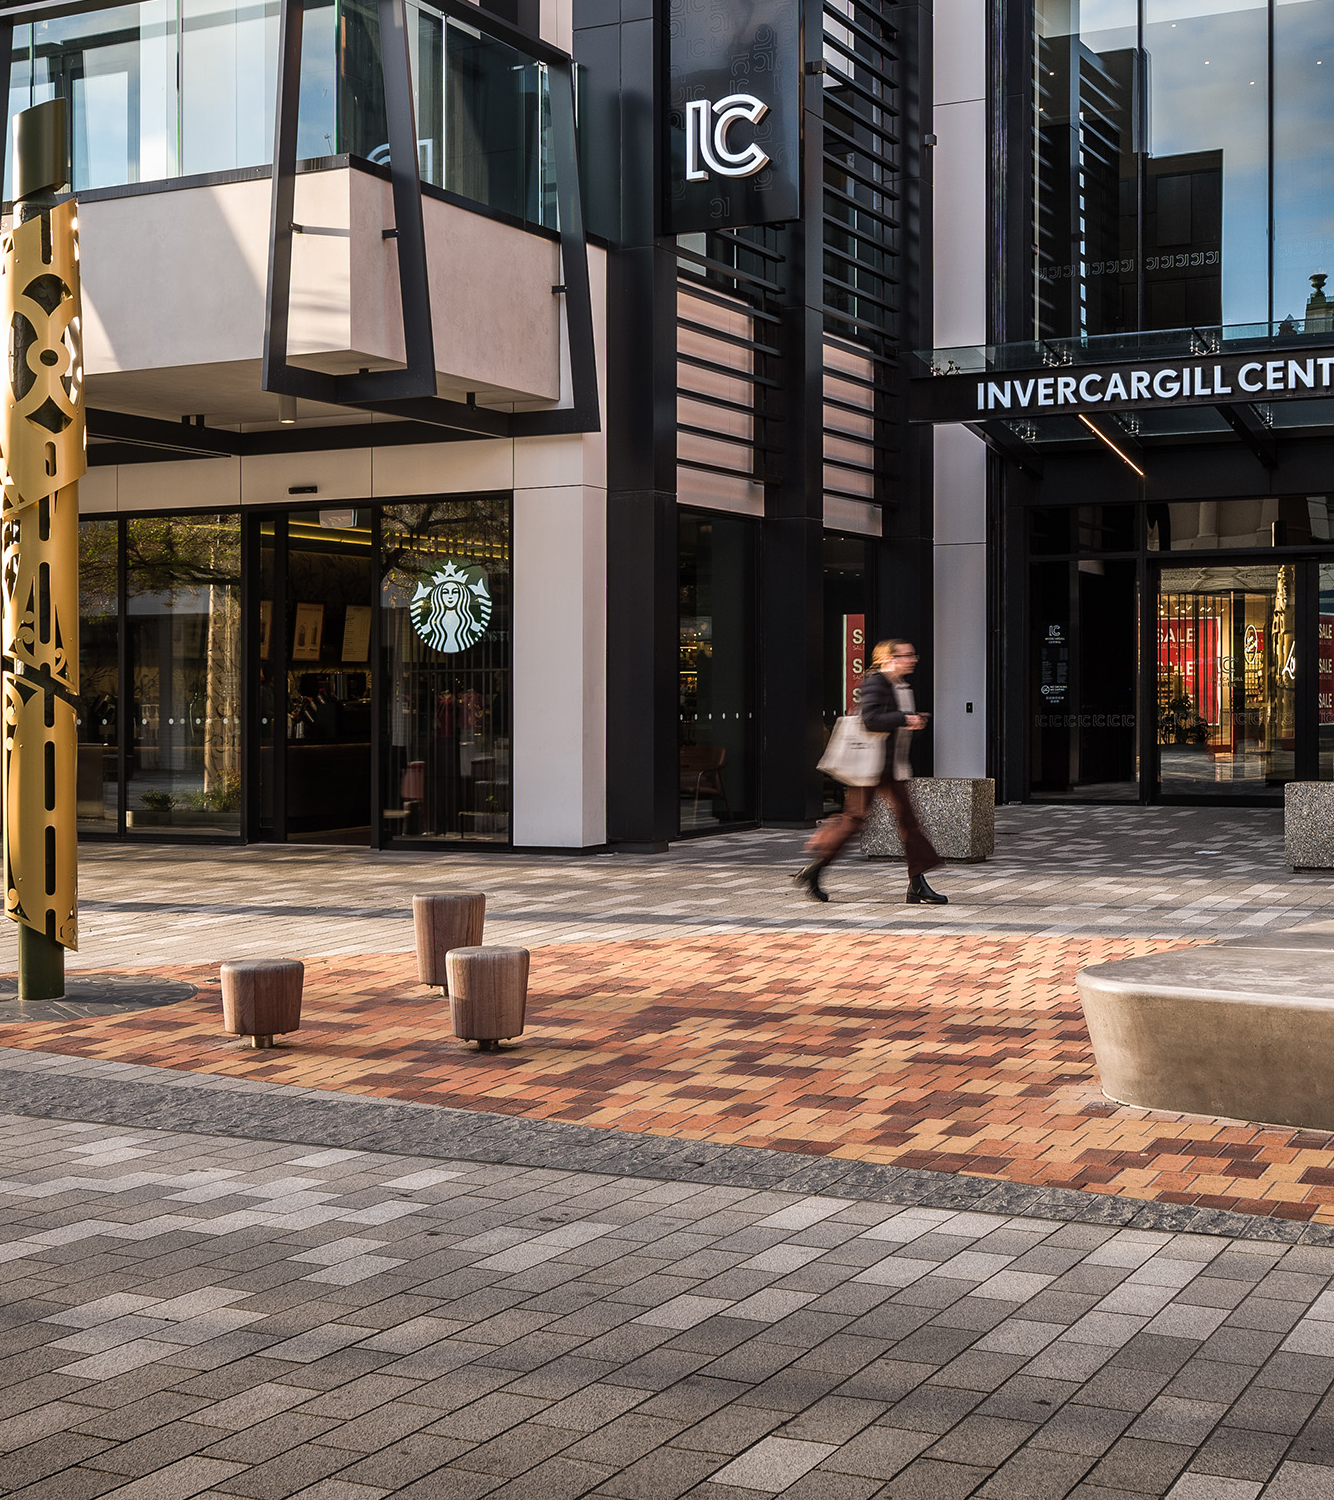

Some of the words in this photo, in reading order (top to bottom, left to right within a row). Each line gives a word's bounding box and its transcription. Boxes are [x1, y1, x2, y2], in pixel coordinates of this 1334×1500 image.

[685, 92, 772, 182] IC
[977, 365, 1232, 411] INVERCARGILL
[1319, 623, 1332, 639] SALE
[1319, 659, 1332, 673] SALE
[1319, 693, 1332, 708] SALE
